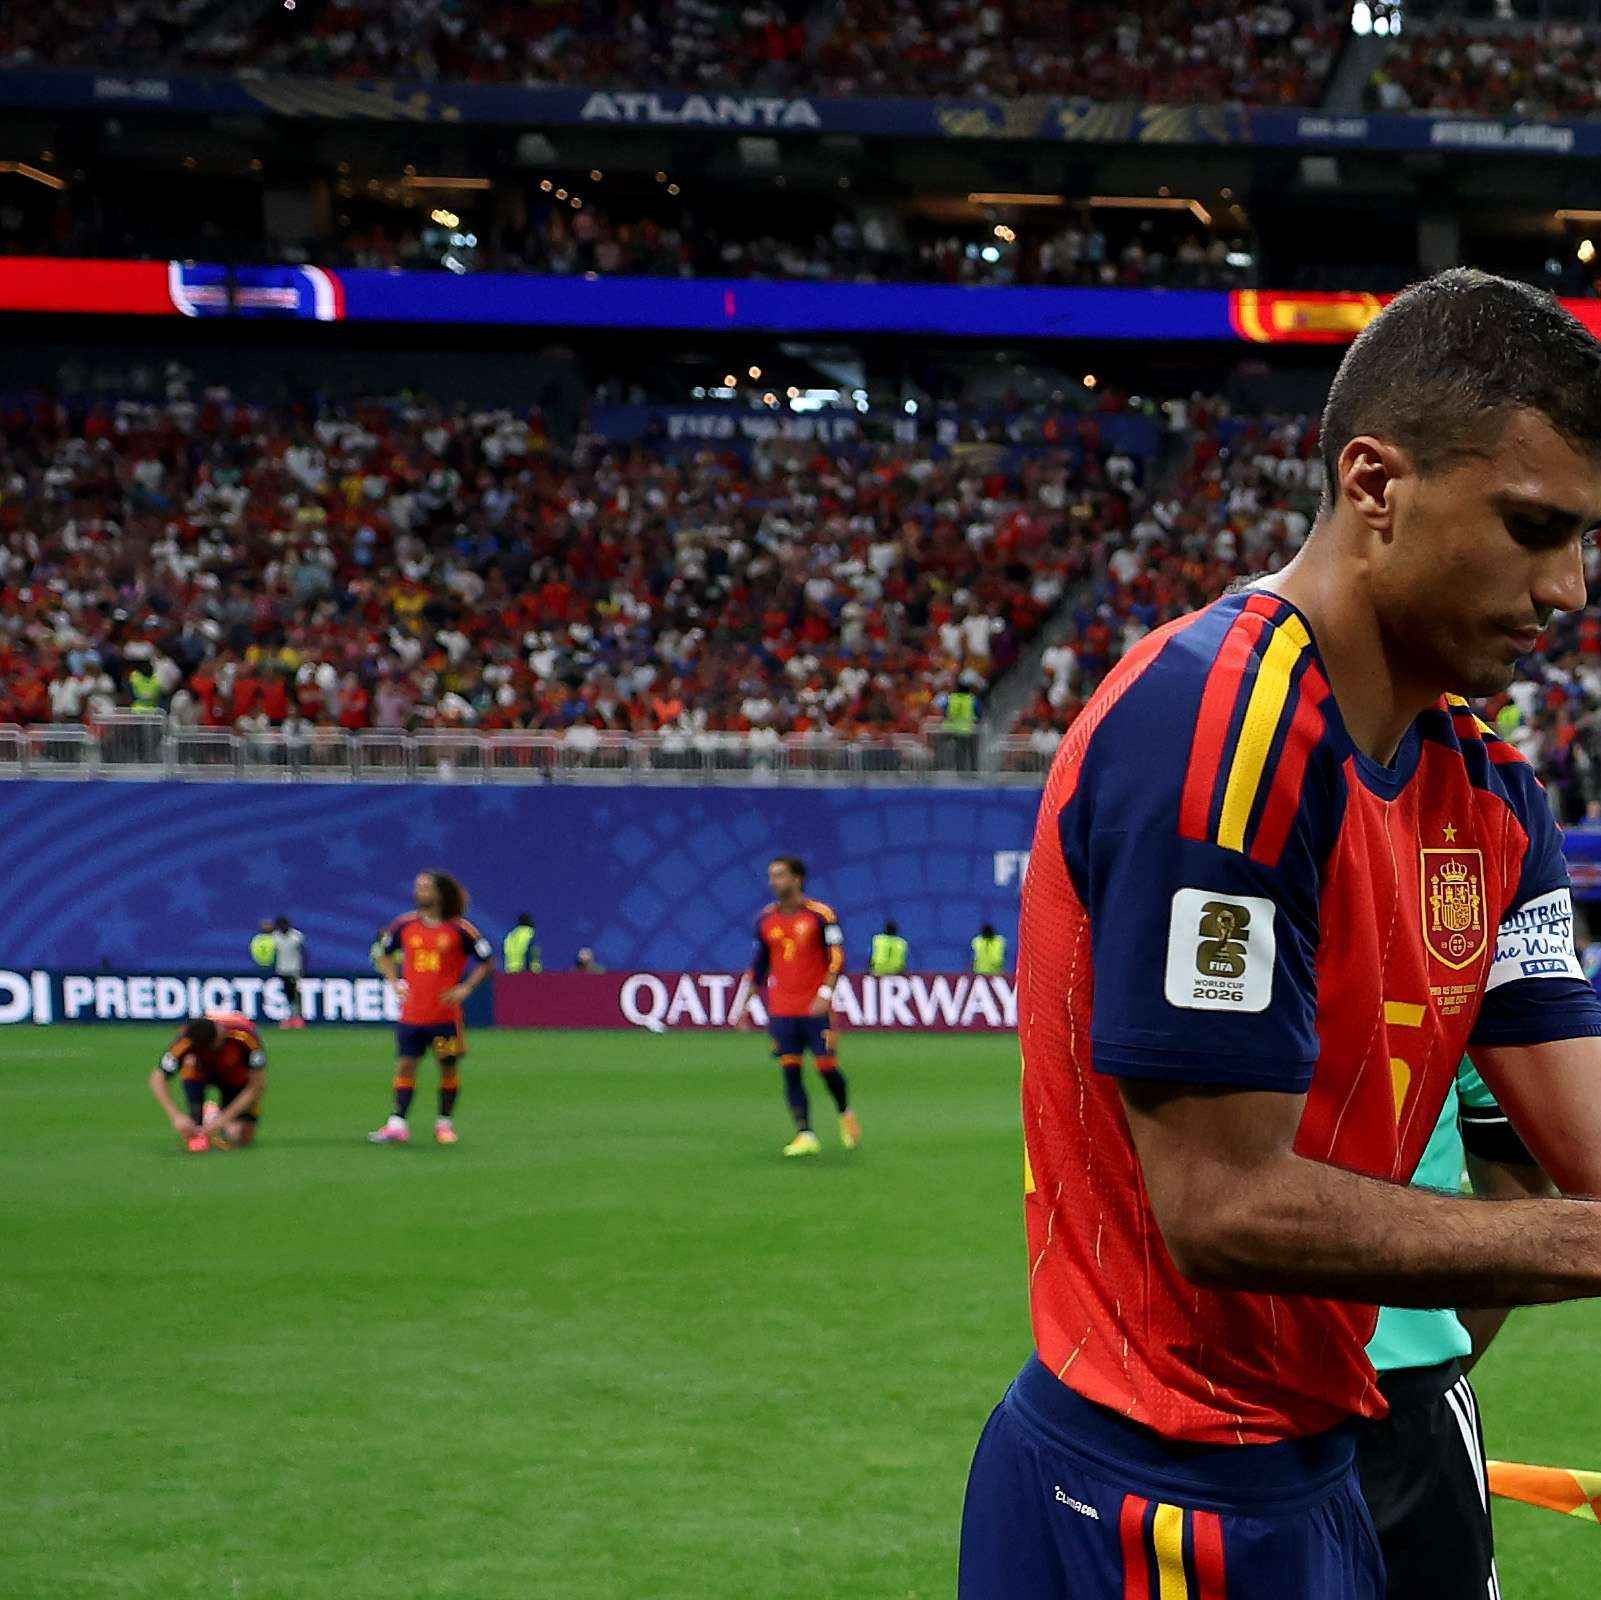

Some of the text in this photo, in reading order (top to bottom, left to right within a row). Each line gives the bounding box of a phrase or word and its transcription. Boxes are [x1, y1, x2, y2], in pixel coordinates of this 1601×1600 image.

[580, 91, 821, 127] ATLANTA
[1209, 961, 1234, 973] FIFA
[1526, 961, 1566, 974] FIFA
[1194, 979, 1245, 989] WORLD CUP
[1193, 988, 1244, 1002] 2026
[620, 974, 1018, 1033] QATA AIRWAY
